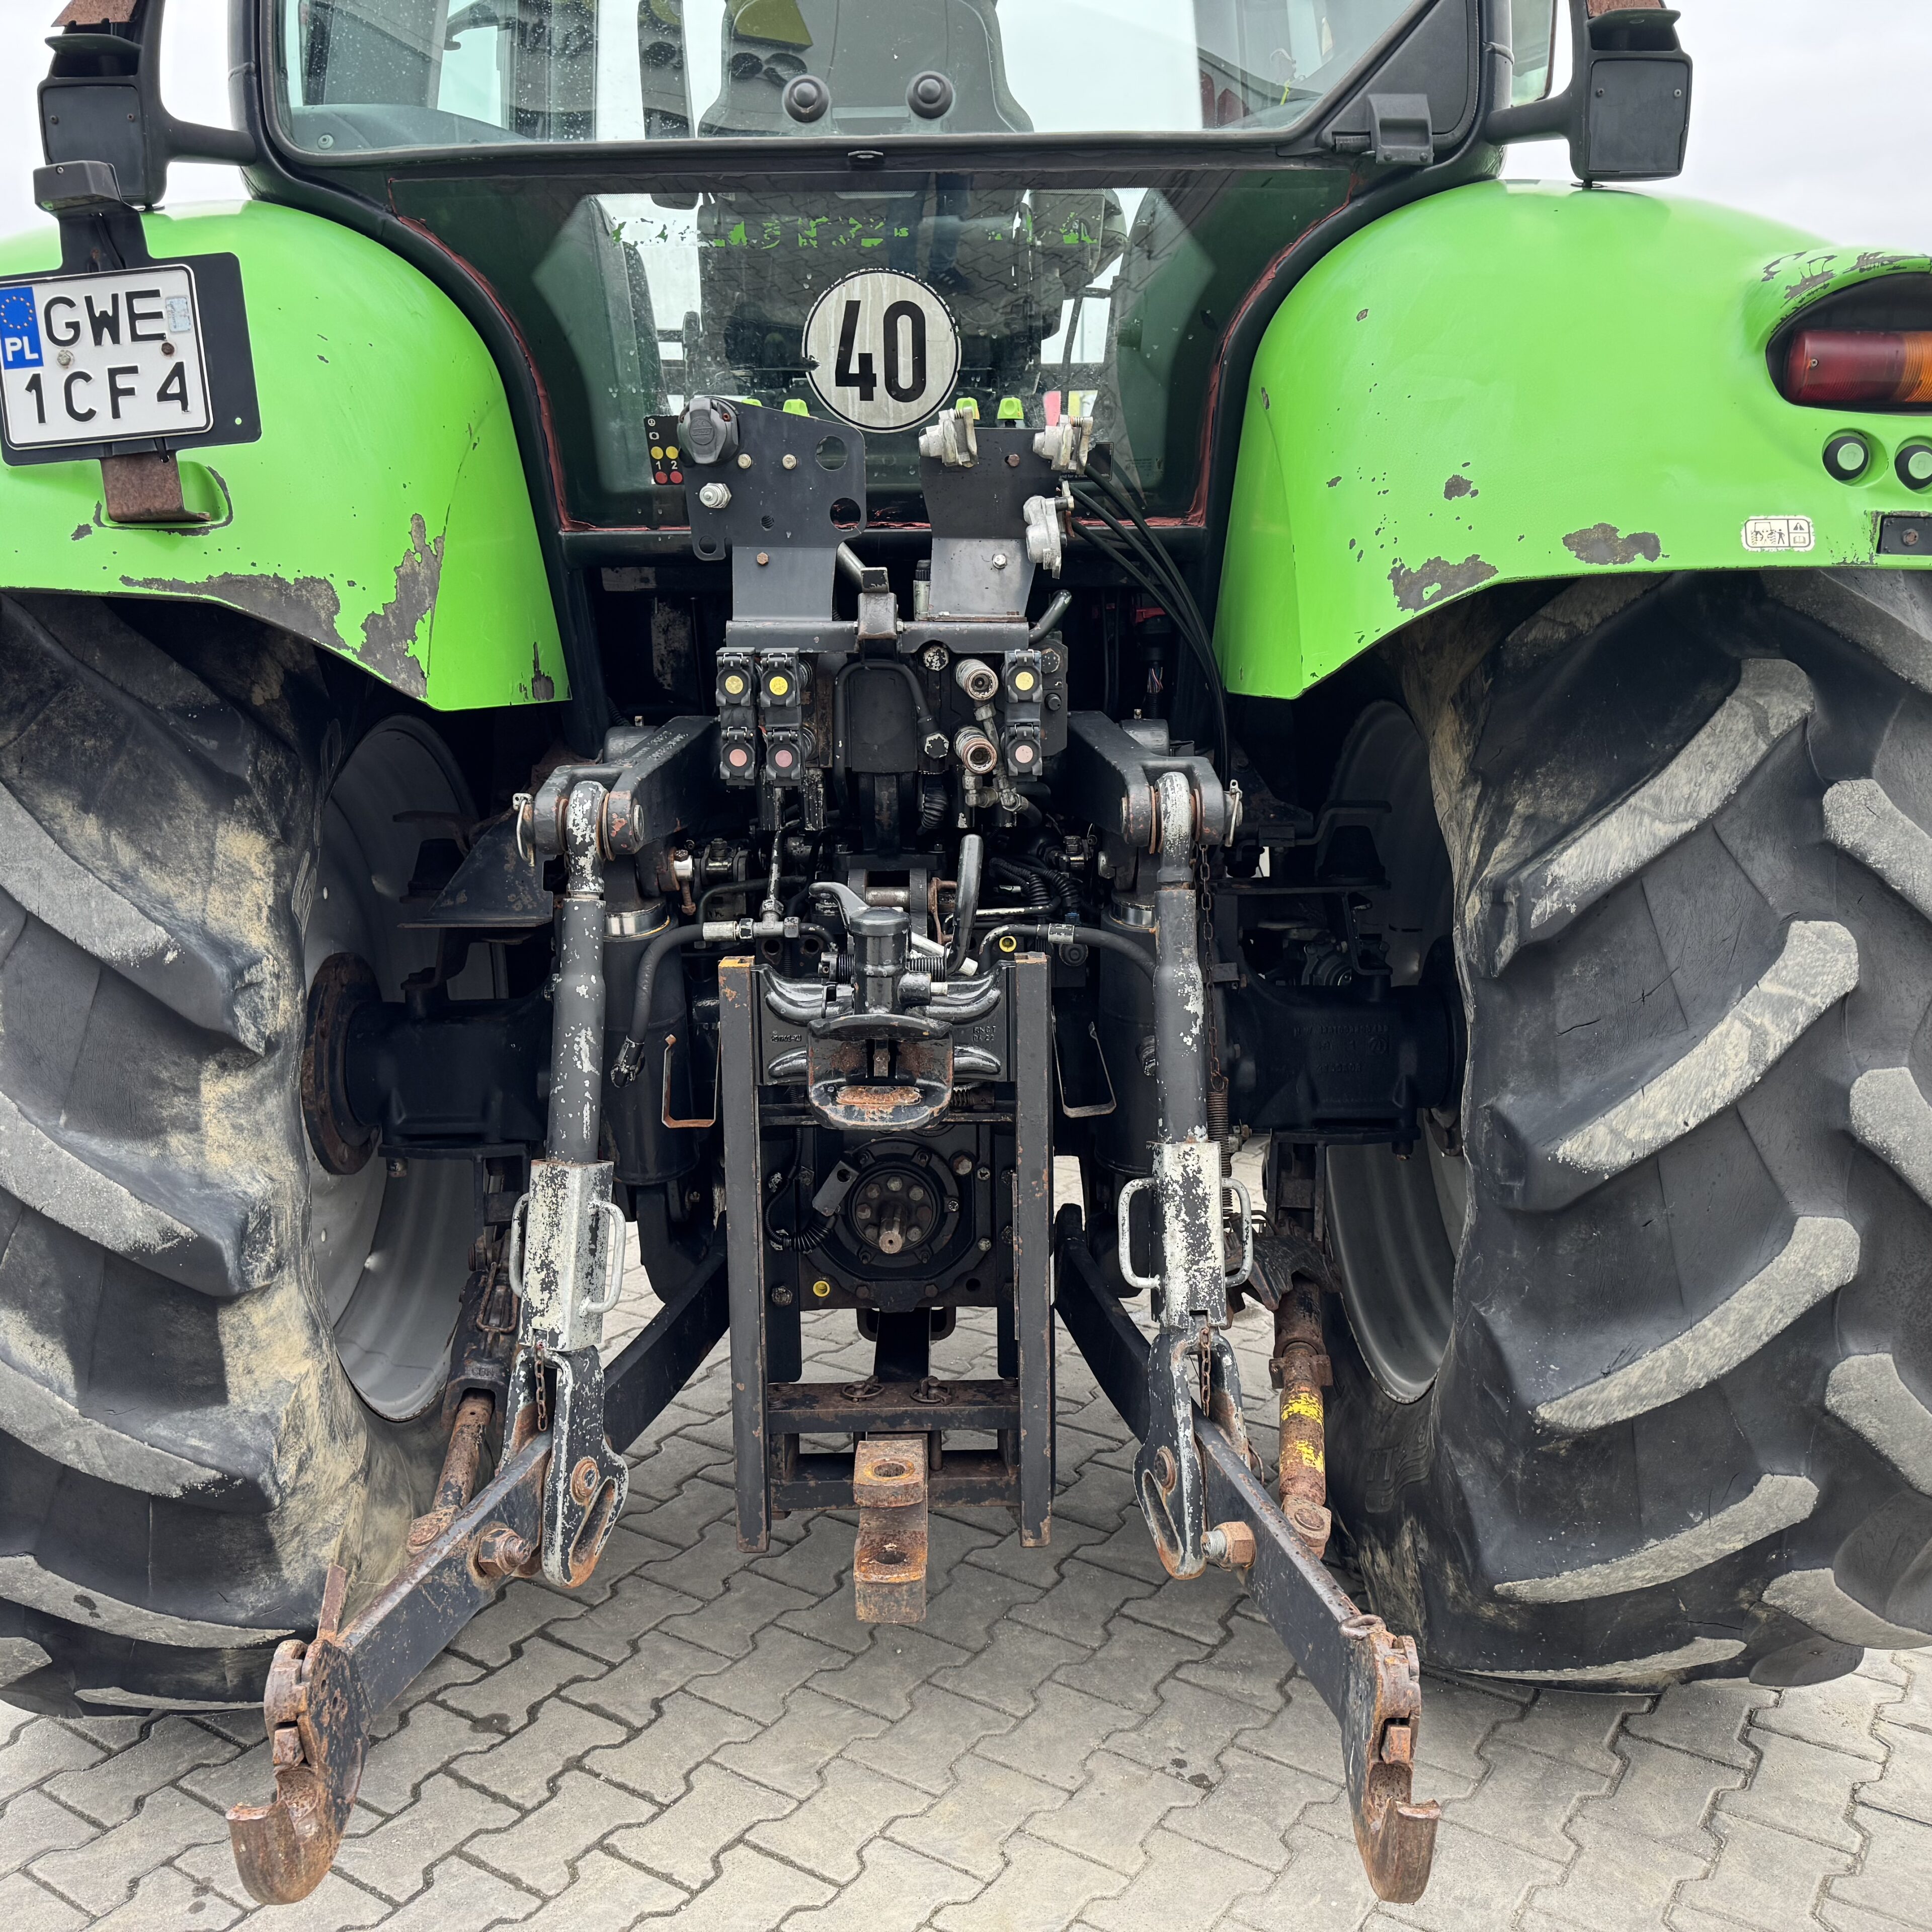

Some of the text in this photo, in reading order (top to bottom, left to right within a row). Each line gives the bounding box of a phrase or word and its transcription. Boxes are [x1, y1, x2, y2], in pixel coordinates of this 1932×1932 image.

[44, 289, 167, 347] GWE
[5, 336, 39, 362] PL
[835, 300, 926, 403] 40
[25, 361, 190, 425] 1CF4
[656, 460, 662, 470] 1
[670, 460, 678, 469] 2
